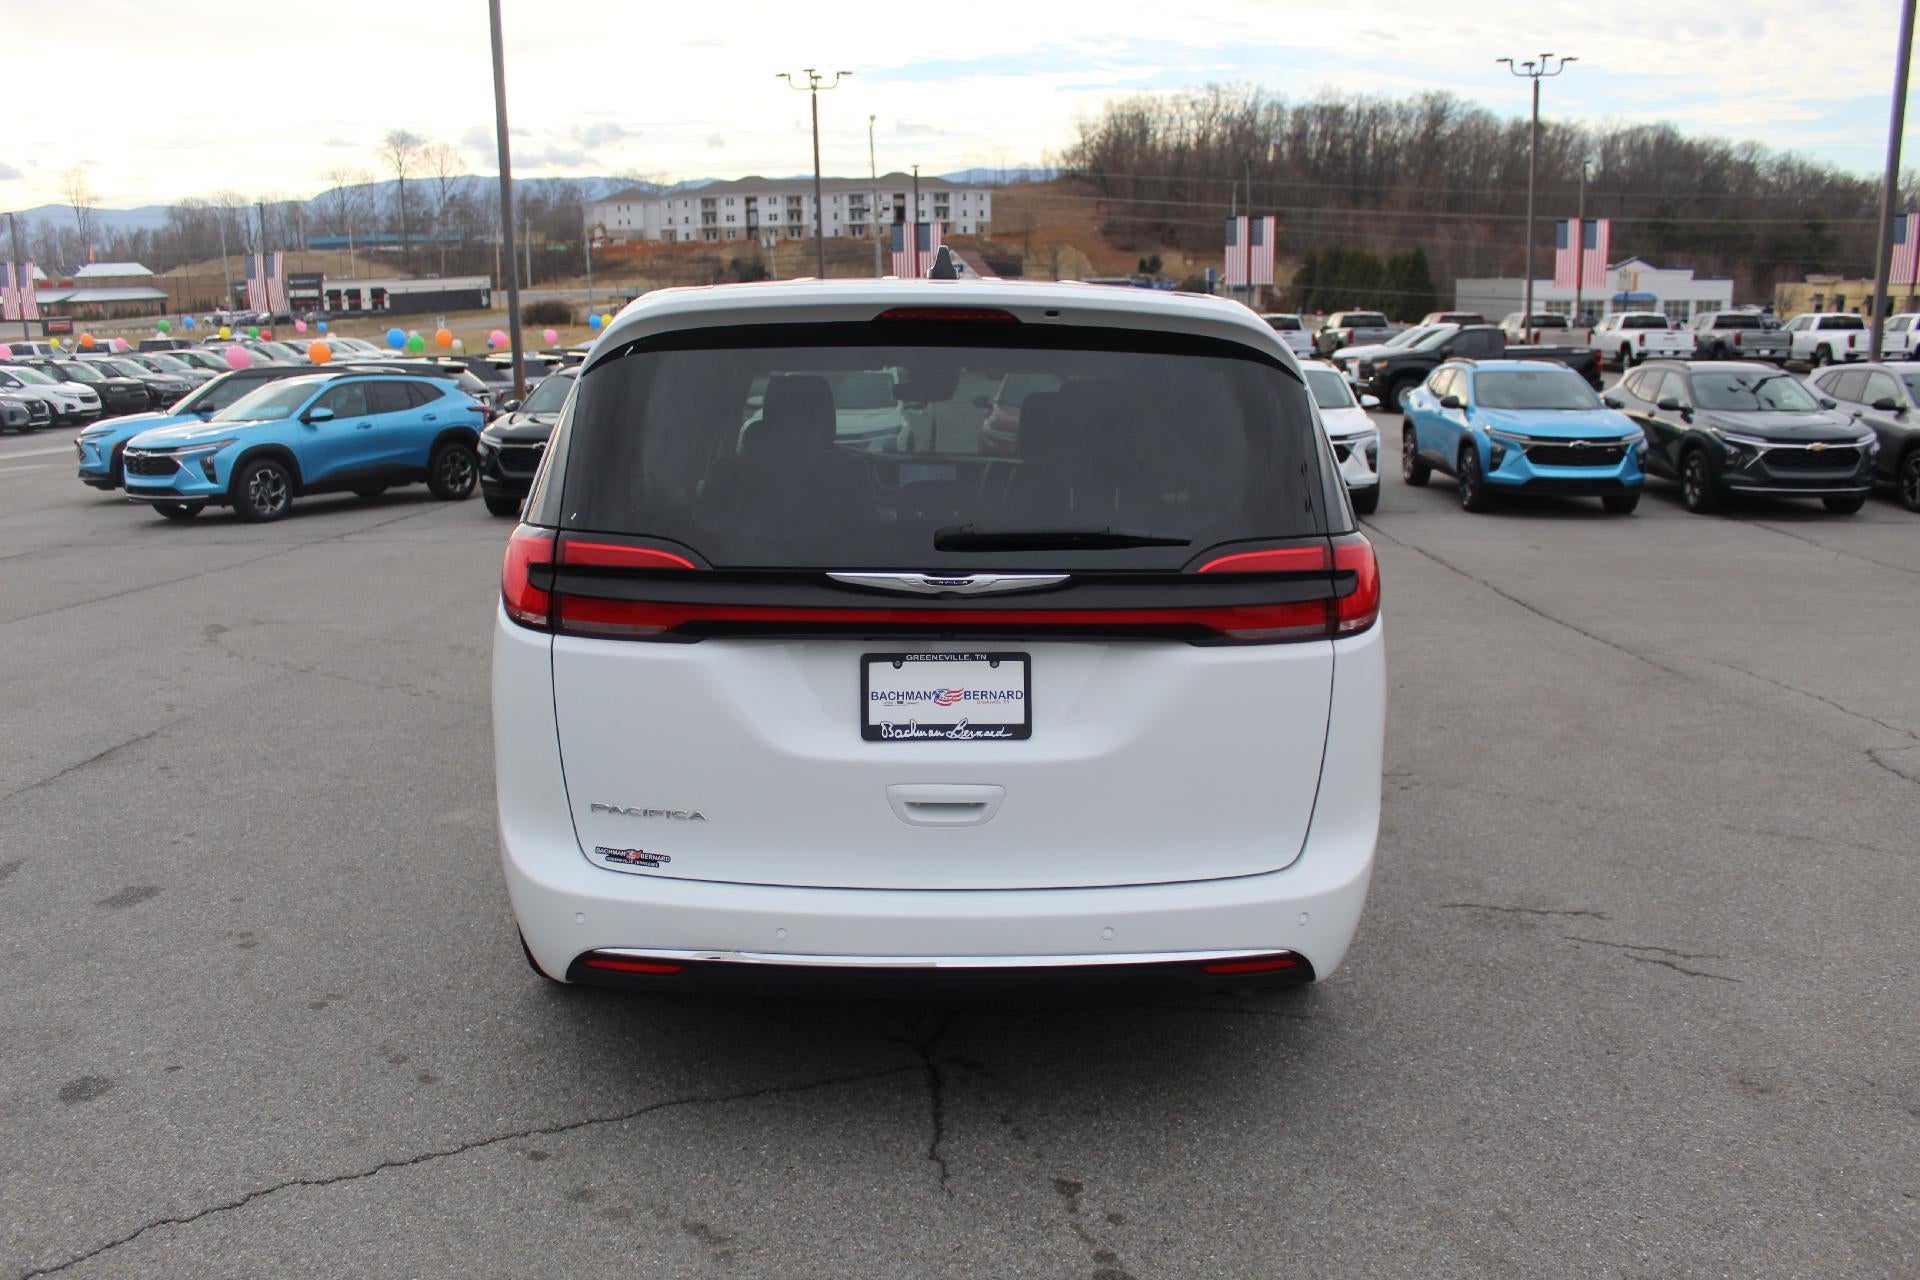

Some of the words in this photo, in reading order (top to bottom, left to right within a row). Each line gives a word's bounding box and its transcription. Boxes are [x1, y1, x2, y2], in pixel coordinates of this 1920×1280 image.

[906, 654, 972, 662] GREENEVILLE,
[871, 691, 933, 701] BACHMAN
[964, 690, 1023, 700] BERNARD
[880, 719, 945, 739] Bachman
[945, 718, 1013, 740] Bernard
[590, 803, 708, 821] PACIFICA
[640, 853, 671, 862] BERNARD
